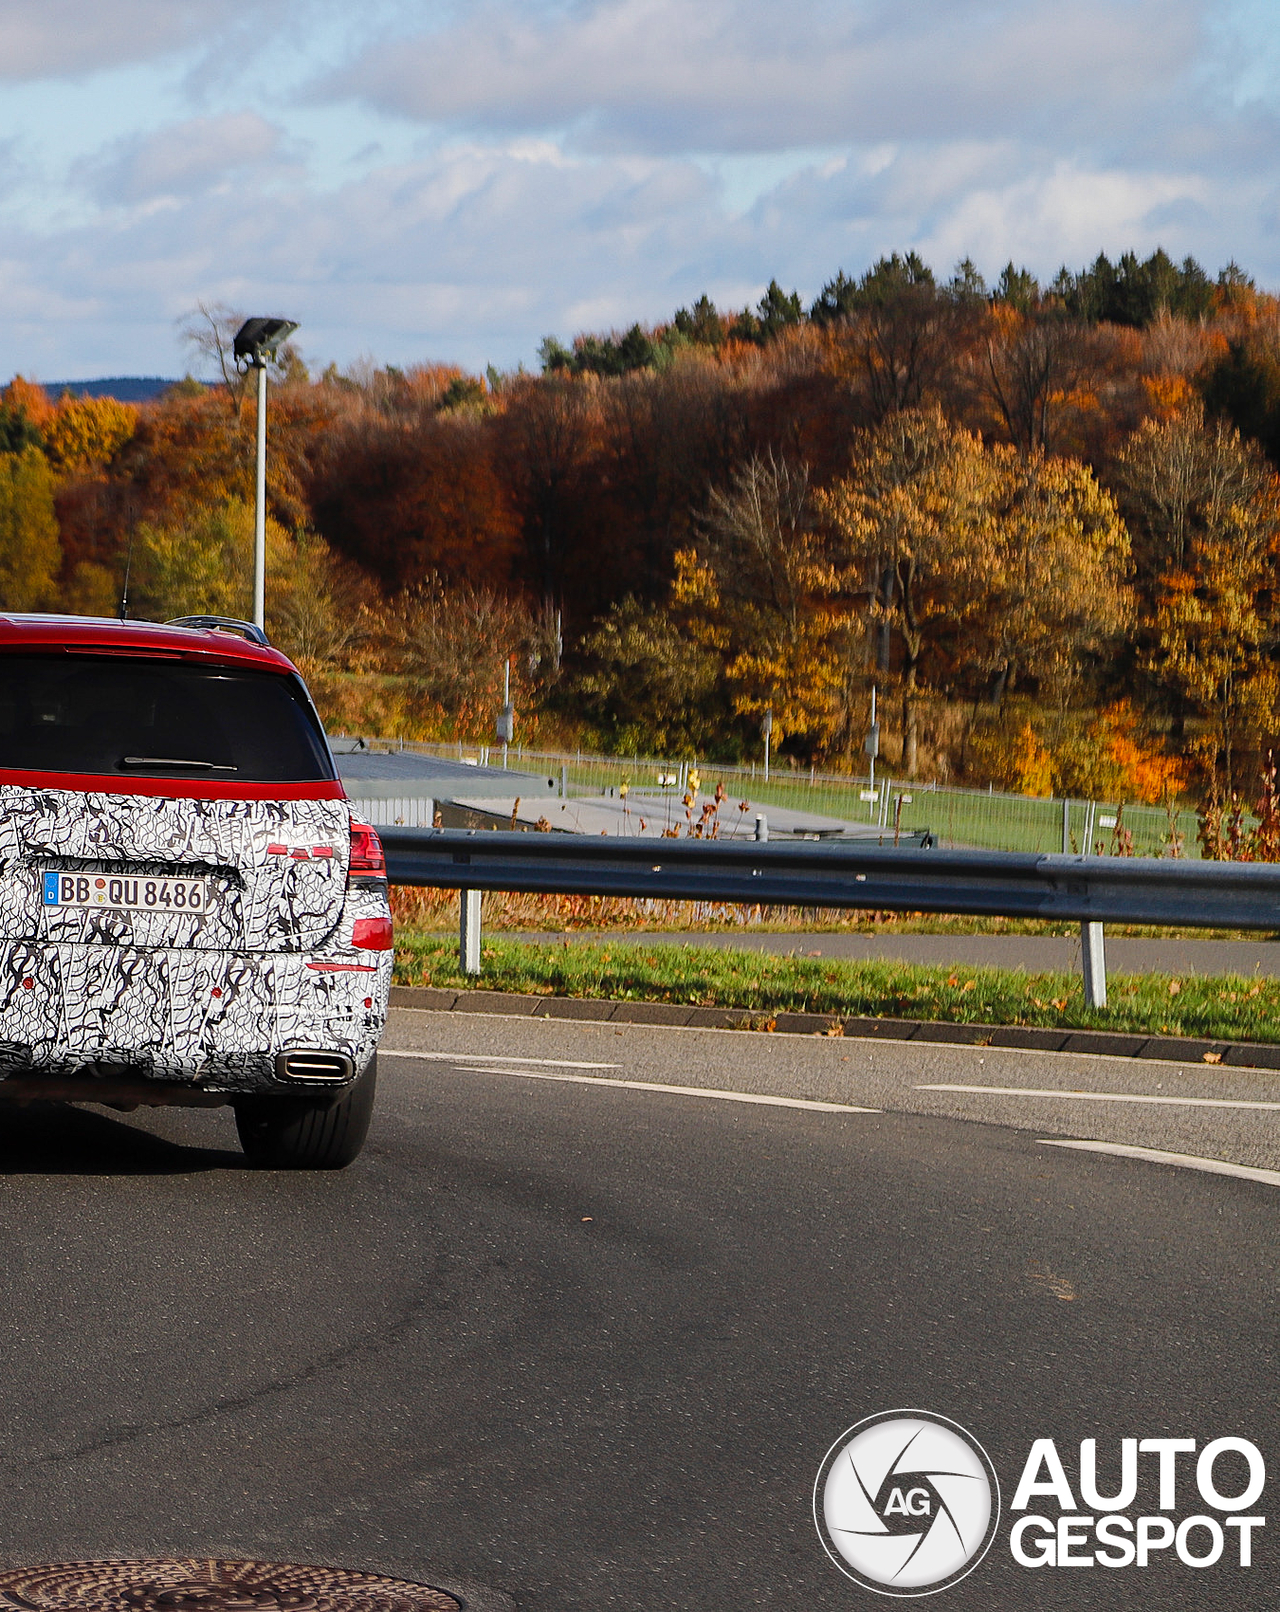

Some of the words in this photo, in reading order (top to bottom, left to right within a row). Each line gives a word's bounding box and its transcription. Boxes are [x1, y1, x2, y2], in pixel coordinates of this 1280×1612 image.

[61, 877, 90, 902] BB
[109, 880, 138, 905] QU
[144, 881, 202, 908] 8486
